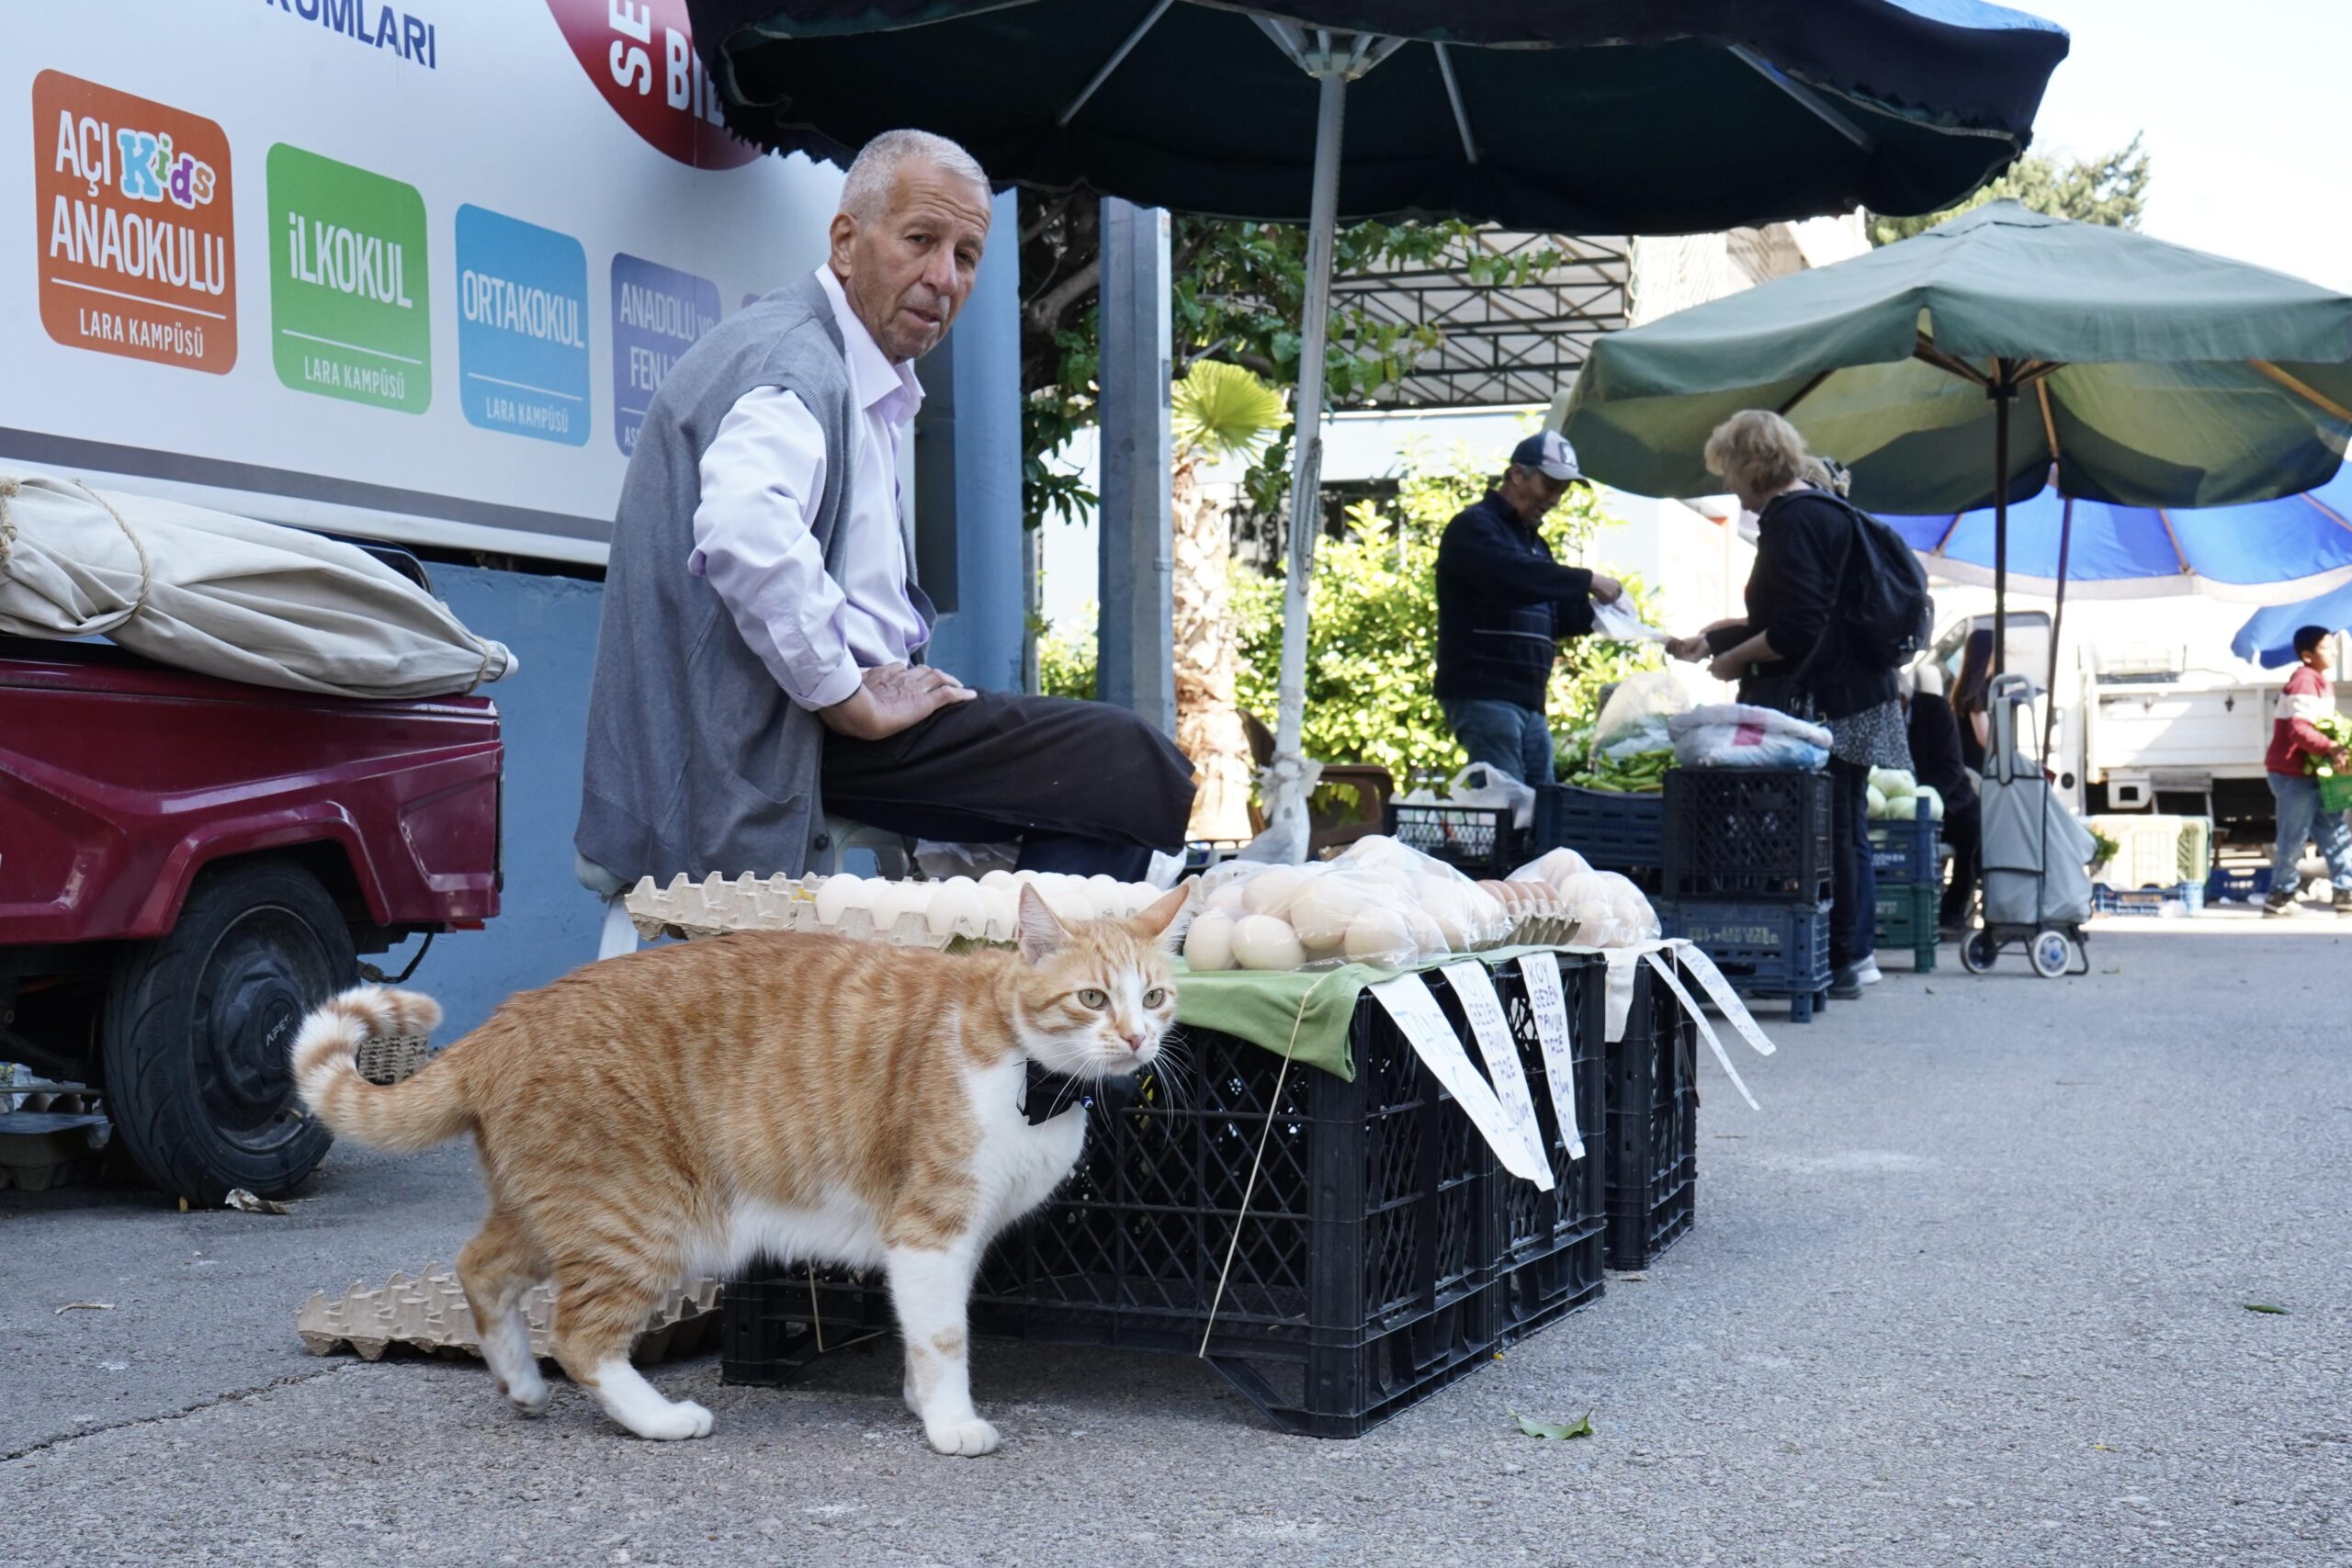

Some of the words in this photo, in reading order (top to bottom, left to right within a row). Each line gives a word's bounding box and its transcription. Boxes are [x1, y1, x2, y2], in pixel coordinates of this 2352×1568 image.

[55, 109, 111, 197] AÇI
[117, 128, 216, 209] Kids
[50, 194, 225, 295] ANAOKULU
[79, 308, 124, 343] LARA
[129, 318, 204, 358] KAMPÜSÜ
[462, 269, 585, 349] ORTAKOKUL
[620, 282, 696, 343] ANADOLU
[304, 355, 340, 387] LARA
[344, 365, 405, 400] KAMPÜSÜ
[630, 345, 663, 392] FEN
[486, 396, 515, 423] LARA
[518, 403, 569, 434] KAMPÜSÜ
